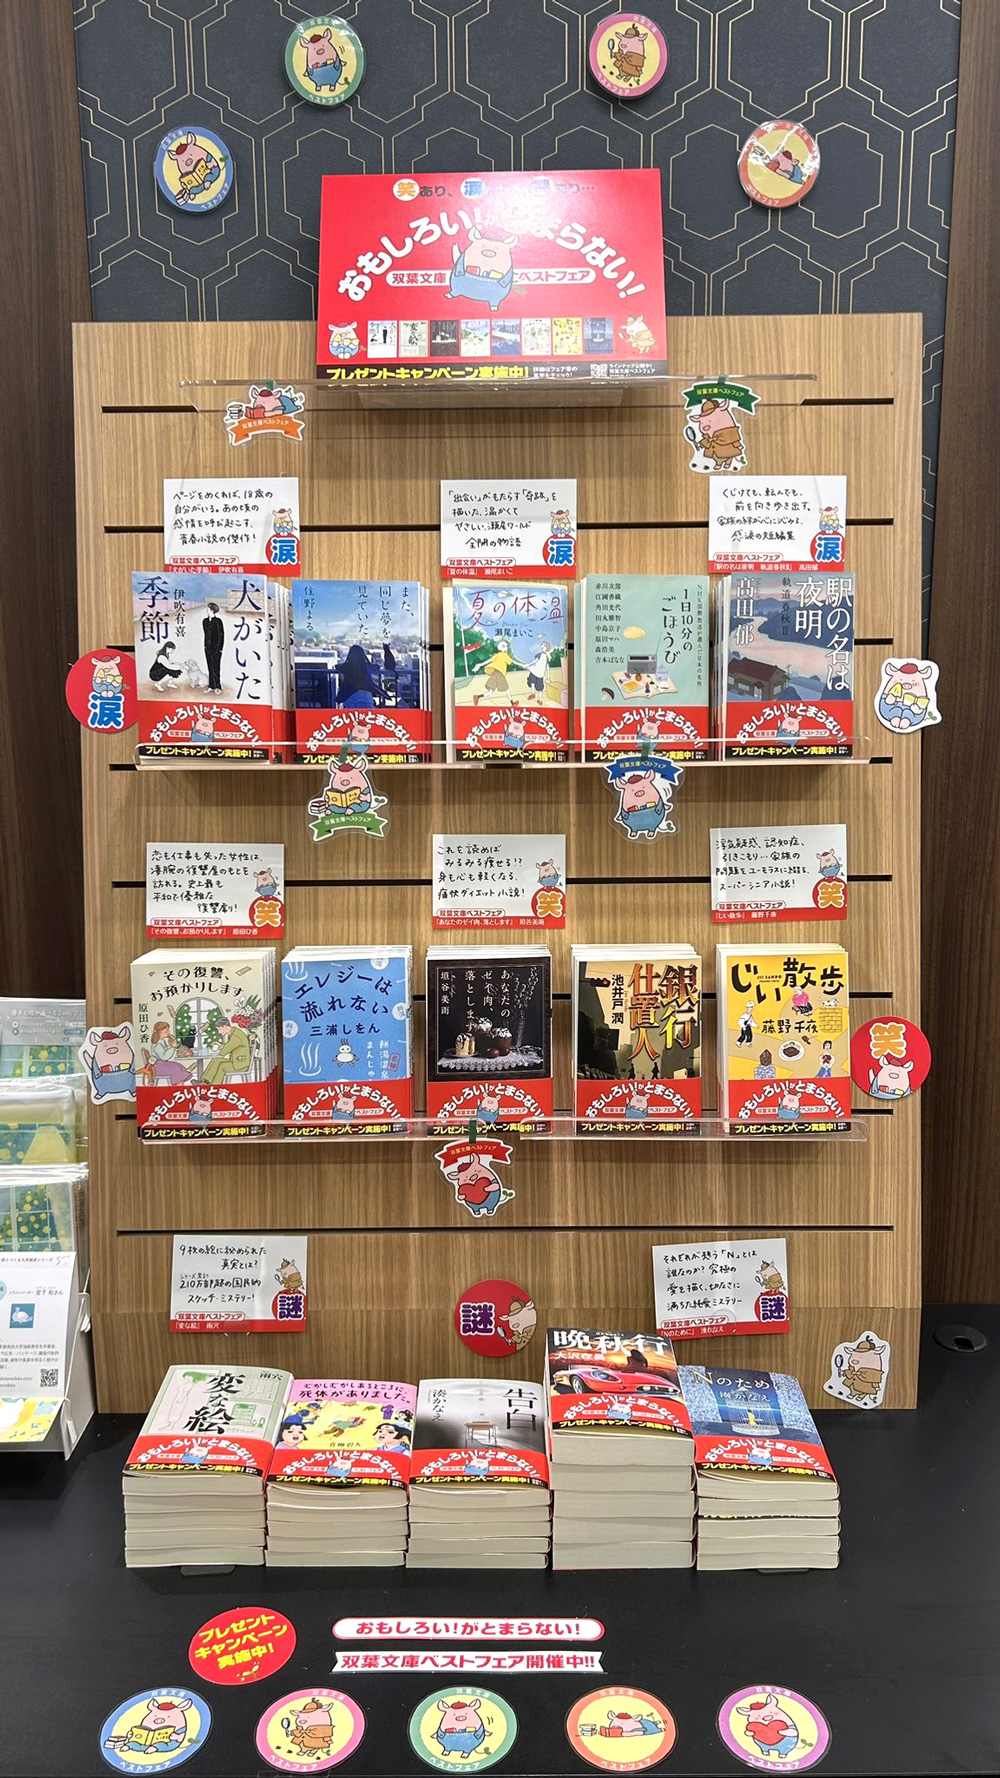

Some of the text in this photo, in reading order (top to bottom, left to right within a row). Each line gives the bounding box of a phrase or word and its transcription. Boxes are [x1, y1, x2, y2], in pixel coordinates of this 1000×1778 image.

[392, 270, 591, 284] 双葉文庫 ベストフェア
[326, 366, 528, 379] プレゼントキャンペーン実施中!
[173, 489, 273, 500] ページをめくれば、18歳の
[448, 489, 557, 502] 「出会い」がもたらす「奇跡」を
[722, 487, 803, 498] くじけても、転んでも、
[174, 504, 259, 514] 自分がいる。あの頃の
[452, 507, 519, 517] 描いた、温かくて
[735, 500, 811, 511] 前を向き歩き出す。
[173, 518, 253, 529] 感情を呼び起こす、
[455, 521, 532, 532] やさしい、瀬尾ワールド
[179, 533, 256, 546] 青春小説の傑作!
[465, 537, 522, 549] 全開の物語
[731, 529, 796, 542] 感涙の短編集
[271, 539, 297, 564] 涙
[548, 540, 573, 565] 涙
[816, 536, 841, 561] 涙
[595, 582, 621, 590] 赤川次郎
[304, 586, 314, 631] 住野よる
[401, 586, 414, 616] また、
[595, 603, 621, 611] 角田光代
[795, 577, 825, 640] 夜明
[137, 575, 169, 643] 季節
[174, 588, 187, 638] 伊吹有喜
[357, 586, 368, 635] 見ていた
[379, 586, 392, 638] 同じ夢を
[467, 589, 564, 630] 夏の体温
[595, 614, 621, 622] 田丸雅智
[681, 589, 693, 652] 1日10分の
[494, 628, 534, 638] 瀬尾まいこ
[661, 596, 680, 664] ごほうび
[825, 577, 853, 691] 駅の名は
[231, 579, 263, 700] 犬がいた
[595, 635, 620, 643] 原田マハ
[595, 645, 615, 653] 森浩美
[595, 656, 625, 664] 吉本ばなな
[88, 692, 124, 728] 涙
[736, 703, 847, 744] おもしろい!がとまらない!
[306, 711, 417, 752] おもしろい!がとまらない!
[145, 746, 252, 758] プレゼントキャンペーン実施中!
[732, 746, 837, 756] プレゼントキャンペーン実施中!
[437, 844, 502, 855] これを読めば
[716, 836, 805, 849] 浮気疑惑、認知症、
[151, 850, 263, 861] 恋も仕事も失った女性は、
[151, 864, 249, 876] 凄腕の復讐屋のもとを
[438, 871, 518, 882] 身も心も軽くなる、
[152, 879, 224, 889] 訪れる。史上最も
[719, 879, 795, 891] スーパーシニア小説!
[153, 891, 214, 902] 平和で優雅な
[438, 887, 525, 900] 痛快ダイエット小説!
[818, 881, 845, 909] 笑
[537, 891, 563, 918] 笑
[719, 902, 783, 910] 双葉文庫ベストフェア
[254, 901, 281, 926] 笑
[751, 911, 777, 919] 藤野千夜
[163, 966, 230, 981] その復讐、
[731, 957, 845, 1005] じい散歩
[294, 966, 393, 1000] エレジーは
[150, 982, 245, 1001] お預かりします
[440, 971, 451, 1015] 垣谷美雨
[500, 970, 511, 1018] あなたの
[465, 970, 477, 1032] 落とします
[611, 974, 625, 1025] 池井戸潤
[659, 964, 700, 1050] 銀行
[300, 995, 389, 1022] 流れない
[628, 962, 661, 1061] 仕置人
[138, 1003, 150, 1043] 原田ひ香
[310, 1023, 380, 1036] 三浦しをん
[761, 1019, 819, 1034] 藤野千夜
[869, 1022, 907, 1059] 笑
[148, 1086, 261, 1126] おもしろい!がとまらない!
[291, 1083, 403, 1125] おもしろい!がとまらない!
[437, 1083, 545, 1124] おもしろい!がとまらない!
[585, 1081, 694, 1119] おもしろい!がとまらない!
[738, 1080, 846, 1119] おもしろい!がとまらない!
[144, 1127, 249, 1138] プレゼントキャンペーン実施中!
[288, 1125, 392, 1136] プレゼントキャンペーン実施中!
[581, 1122, 685, 1132] プレゼントキャンペーン実施中!
[735, 1123, 836, 1134] プレゼントキャンペーン実施中!
[179, 1244, 267, 1256] 9枚の絵に秘められた
[221, 1258, 259, 1270] 真実とは?
[666, 1281, 741, 1296] 愛を描く、切なさに
[278, 1294, 304, 1320] 謎
[667, 1297, 743, 1312] 満ちた純愛ミステリー
[760, 1296, 787, 1322] 謎
[460, 1302, 495, 1336] 謎
[664, 1317, 726, 1328] 双葉文庫ベストフェア
[553, 1330, 668, 1356] 晩秋行
[555, 1351, 606, 1361] 大沢在昌
[259, 1371, 284, 1381] 雨穴
[304, 1382, 407, 1394] むかしむかしあるところに、
[182, 1372, 246, 1435] 変な絵
[299, 1389, 410, 1404] 死体がありました。
[719, 1391, 772, 1403] 湊かなえ
[432, 1388, 447, 1422] 湊かなえ
[503, 1388, 538, 1431] 告白
[559, 1420, 675, 1431] プレゼントキャンペーン実施中!
[137, 1437, 258, 1467] おもしろい!がとまらない!
[129, 1463, 244, 1472] プレゼントキャンペーン実施中!
[282, 1450, 403, 1479] おもしろい!がとまらない!
[420, 1449, 541, 1478] おもしろい!がとまらない!
[701, 1463, 817, 1476] プレゼントキャンペーン実施中!
[276, 1475, 390, 1486] プレゼントキャンペーン実施中!
[415, 1476, 530, 1485] プレゼントキャンペーン実施中!
[198, 1614, 275, 1643] プレゼント
[355, 1621, 580, 1636] おもしろい!がとまらない!
[194, 1624, 288, 1659] キャンペーン
[217, 1642, 274, 1669] 実施中!
[341, 1654, 595, 1669] 双葉文庫ベストフェア開催中!!
[151, 1689, 187, 1698] 双葉文庫
[312, 1690, 346, 1700] 双葉文庫
[456, 1688, 490, 1698] 双葉文庫
[600, 1689, 634, 1697] 双葉文庫
[755, 1687, 791, 1697] 双葉文庫
[119, 1760, 172, 1772] ベストフェア
[270, 1754, 318, 1771] ベストフェア
[429, 1757, 481, 1771] ベストフェア
[600, 1757, 652, 1770] ベストフェア
[748, 1755, 800, 1770] ベストフェア
